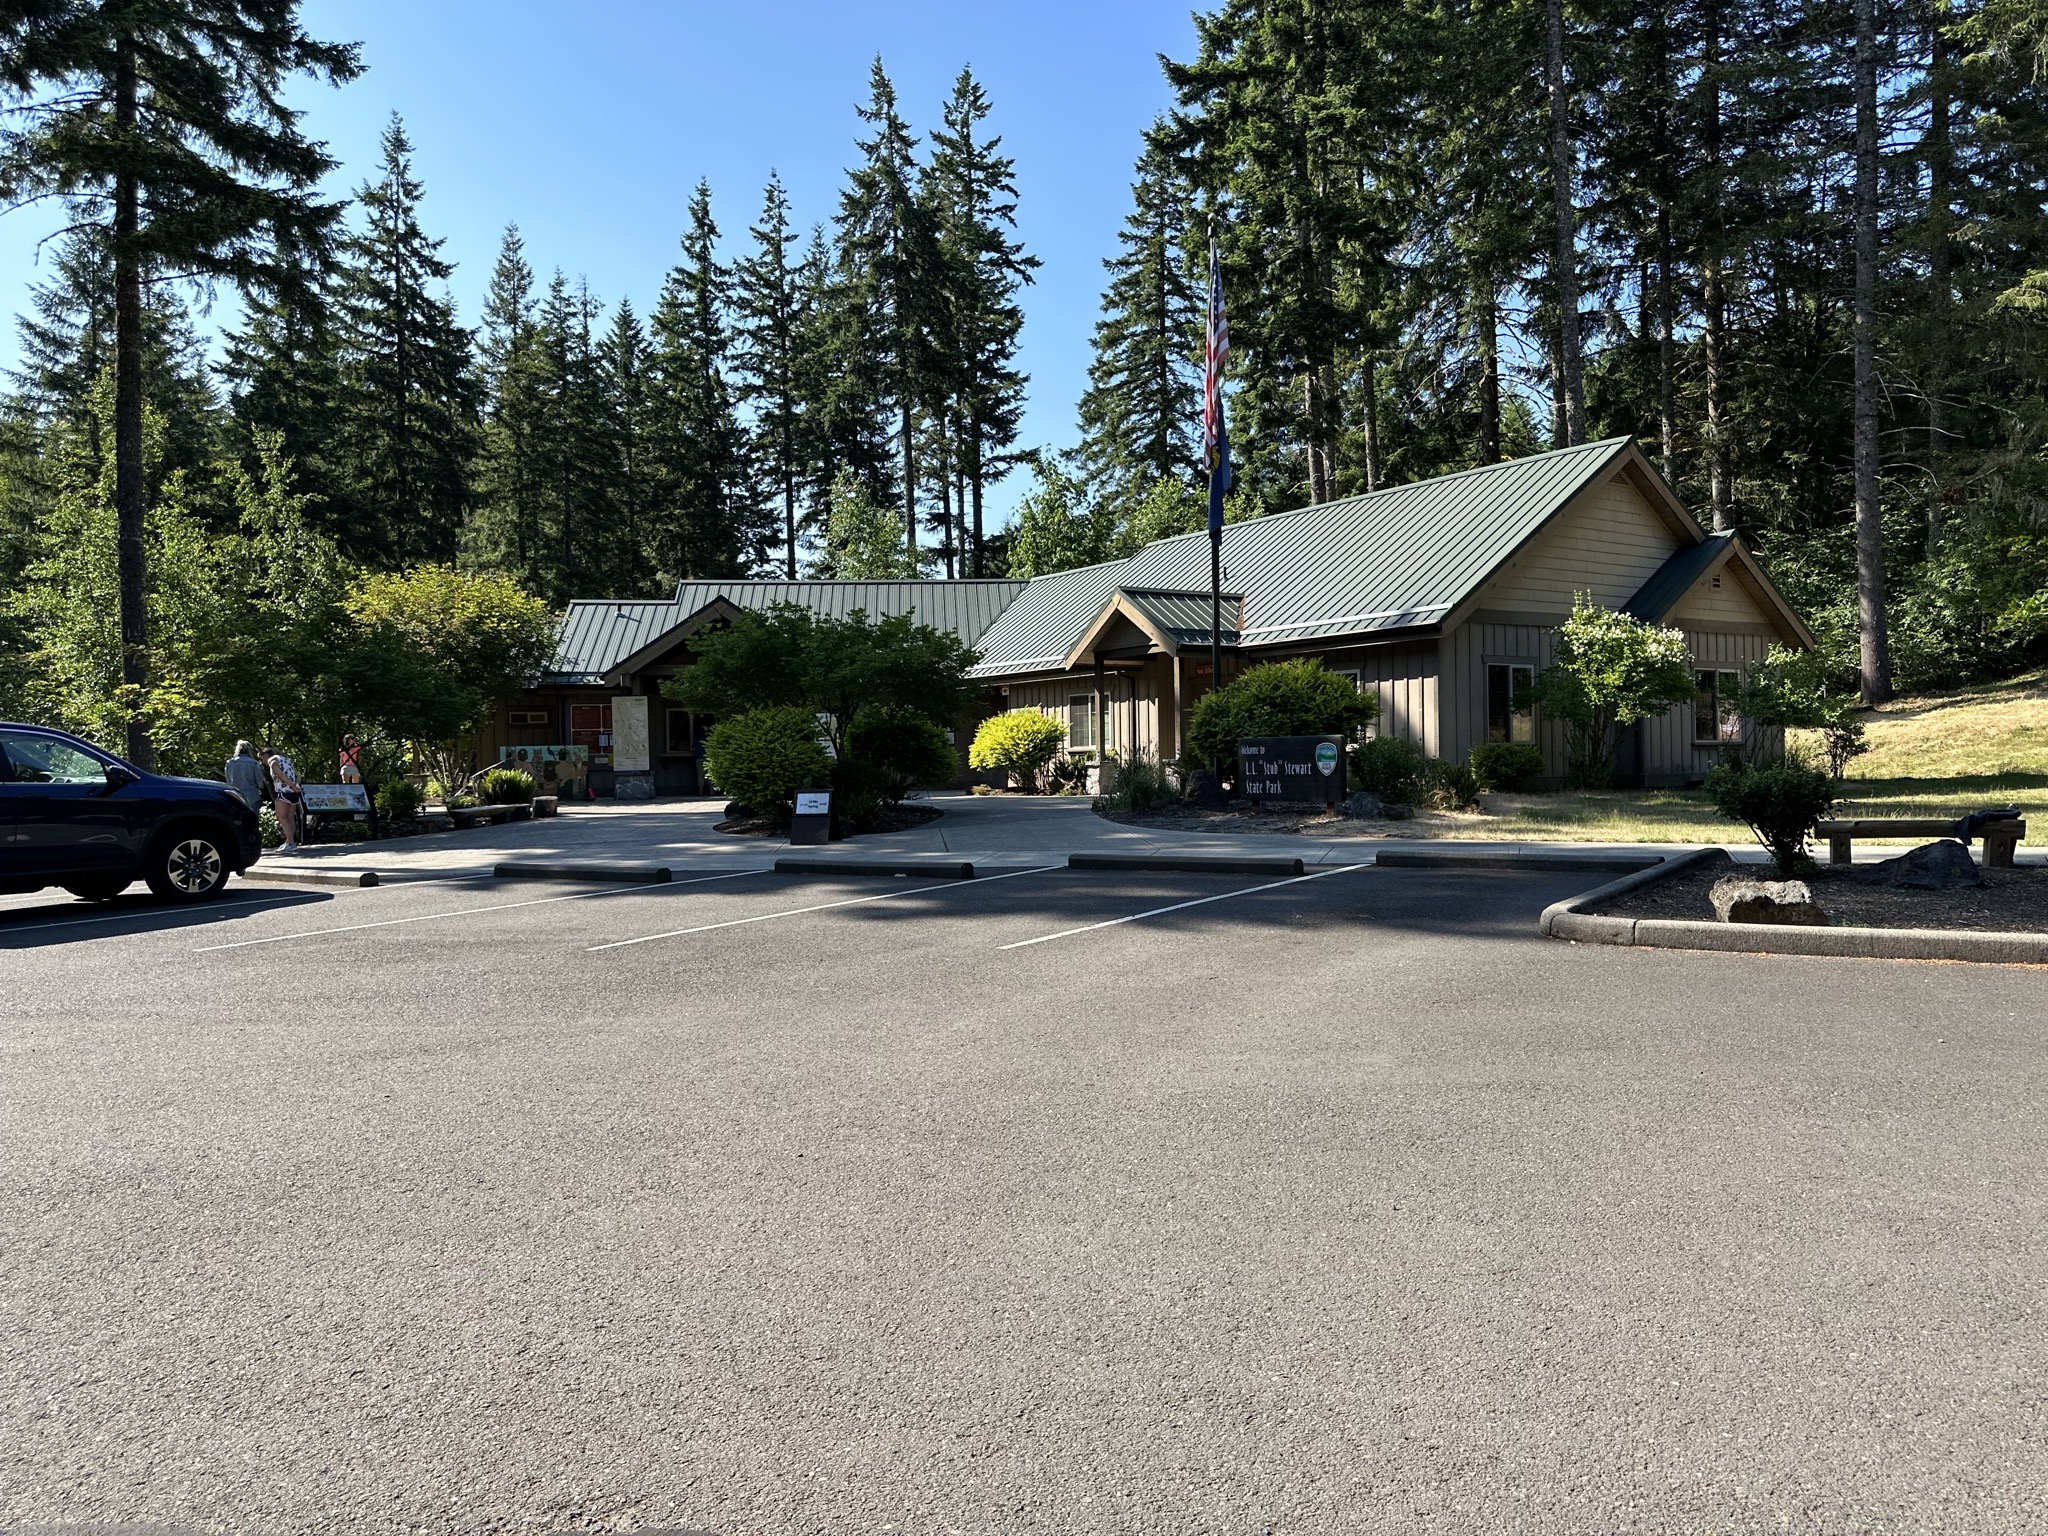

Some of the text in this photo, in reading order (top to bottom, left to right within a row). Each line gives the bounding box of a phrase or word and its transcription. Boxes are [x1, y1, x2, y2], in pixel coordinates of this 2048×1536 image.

[1241, 745, 1265, 755] Welcome to
[1245, 761, 1258, 775] L.L.
[1259, 759, 1282, 775] "Stub"
[1284, 761, 1312, 775] Stewart
[1246, 780, 1282, 794] State Park
